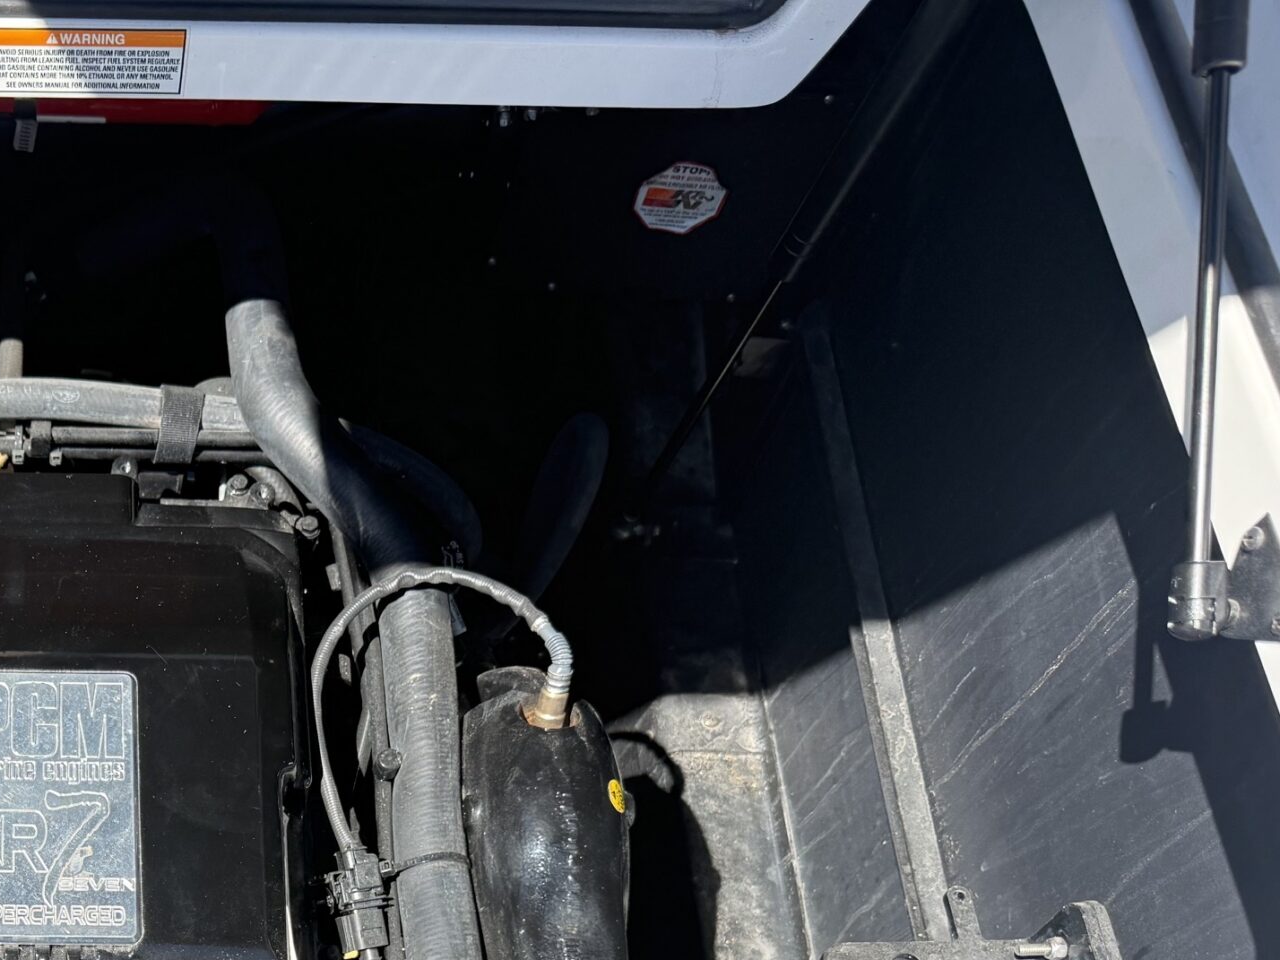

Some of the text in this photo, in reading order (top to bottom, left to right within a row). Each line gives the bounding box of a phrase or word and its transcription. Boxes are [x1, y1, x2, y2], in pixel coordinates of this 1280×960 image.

[60, 33, 125, 45] WARNING
[43, 757, 125, 785] engines
[58, 877, 136, 892] SEVEN
